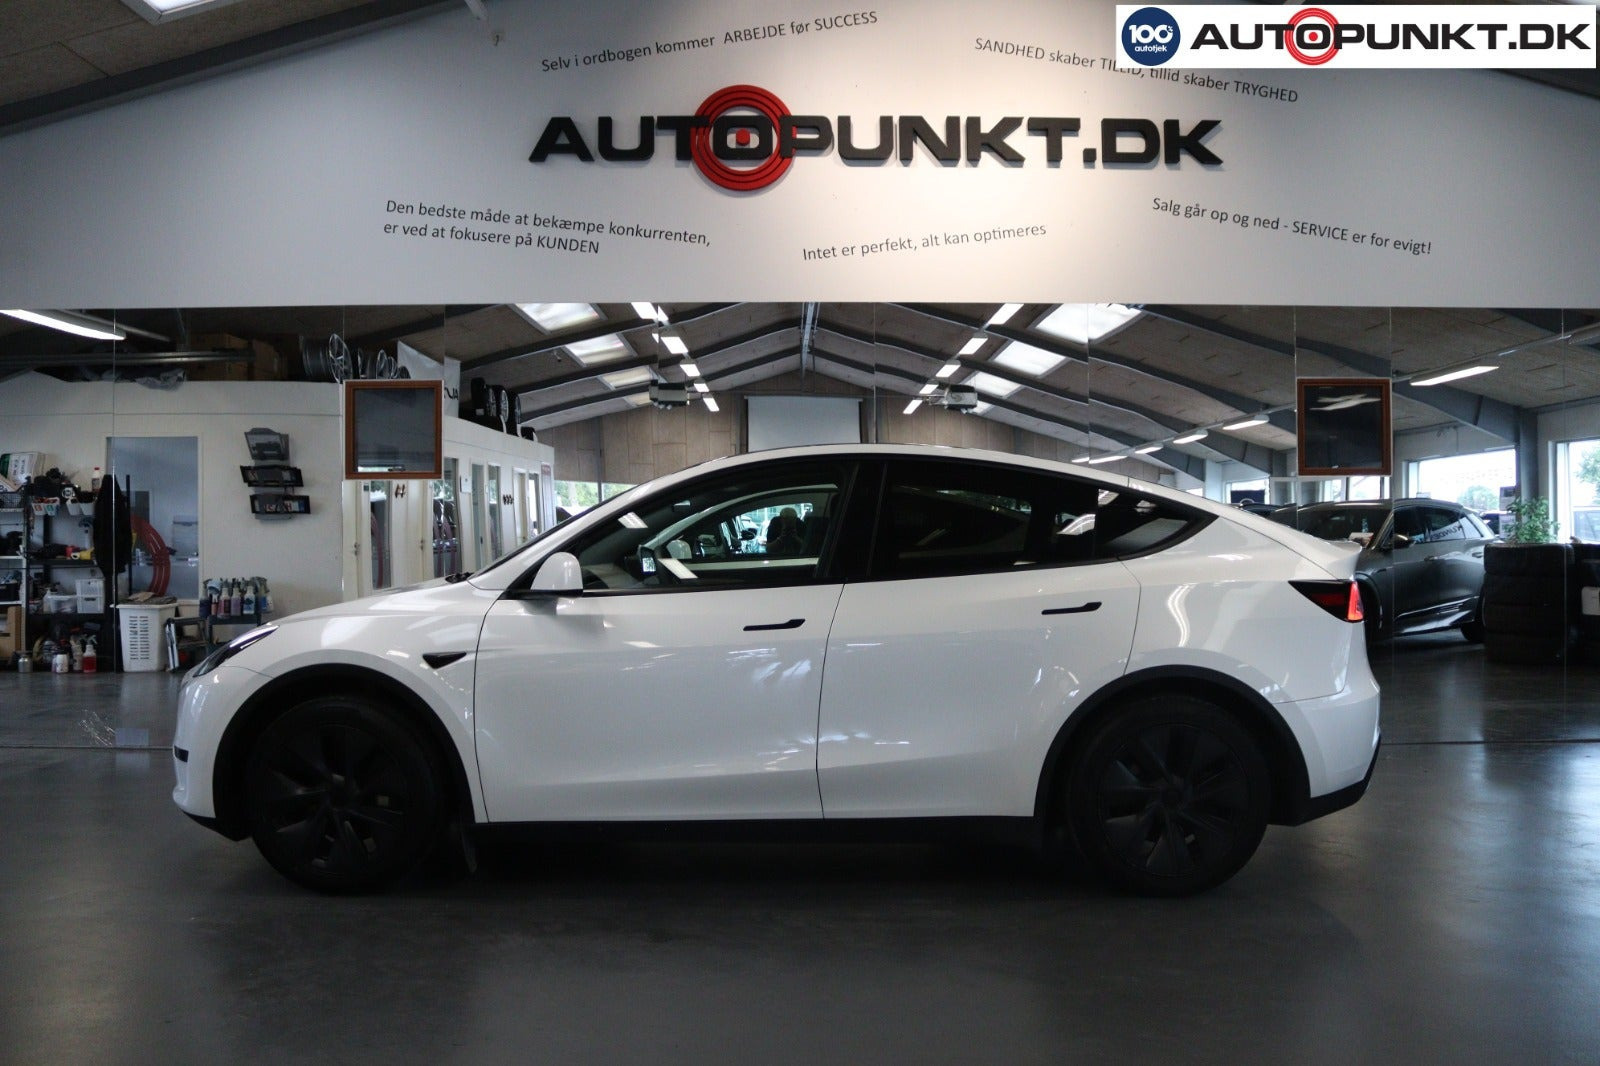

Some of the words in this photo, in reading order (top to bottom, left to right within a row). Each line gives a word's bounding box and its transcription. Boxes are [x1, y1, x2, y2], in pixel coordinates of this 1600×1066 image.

[541, 55, 571, 73] Selv
[574, 53, 579, 67] i
[582, 47, 652, 66] ordbogen
[655, 36, 716, 55] kommer
[723, 24, 787, 45] ARBEJDE
[789, 21, 811, 37] før
[814, 10, 878, 32] SUCCESS
[974, 37, 1046, 60] SANDHED
[1048, 50, 1097, 68] skaber
[1149, 68, 1181, 83] tillid
[1183, 70, 1231, 92] skaber
[1233, 80, 1299, 103] TRYGHED
[528, 115, 1223, 165] AUTOPUNKT.DK
[383, 223, 400, 234] er
[402, 223, 428, 237] ved
[431, 226, 447, 239] at
[449, 225, 511, 245] fokusere
[514, 231, 533, 249] på
[536, 234, 600, 255] KUNDEN
[386, 199, 415, 215] Den
[418, 202, 467, 220] bedste
[470, 207, 511, 224] måde
[514, 213, 530, 226] at
[532, 212, 605, 235] bekæmpe
[608, 220, 711, 248] konkurrenten,
[802, 244, 838, 261] Intet
[841, 245, 857, 257] er
[860, 236, 918, 258] perfekt,
[921, 233, 941, 248] alt
[943, 232, 970, 246] kan
[973, 224, 1047, 245] optimeres
[1152, 197, 1182, 217] Salg
[1183, 202, 1208, 220] går
[1210, 209, 1229, 225] op
[1232, 212, 1250, 229] og
[1252, 216, 1281, 231] ned
[1291, 220, 1349, 242] SERVICE
[1351, 232, 1368, 244] er
[1370, 232, 1391, 248] for
[1392, 237, 1432, 256] evigt!
